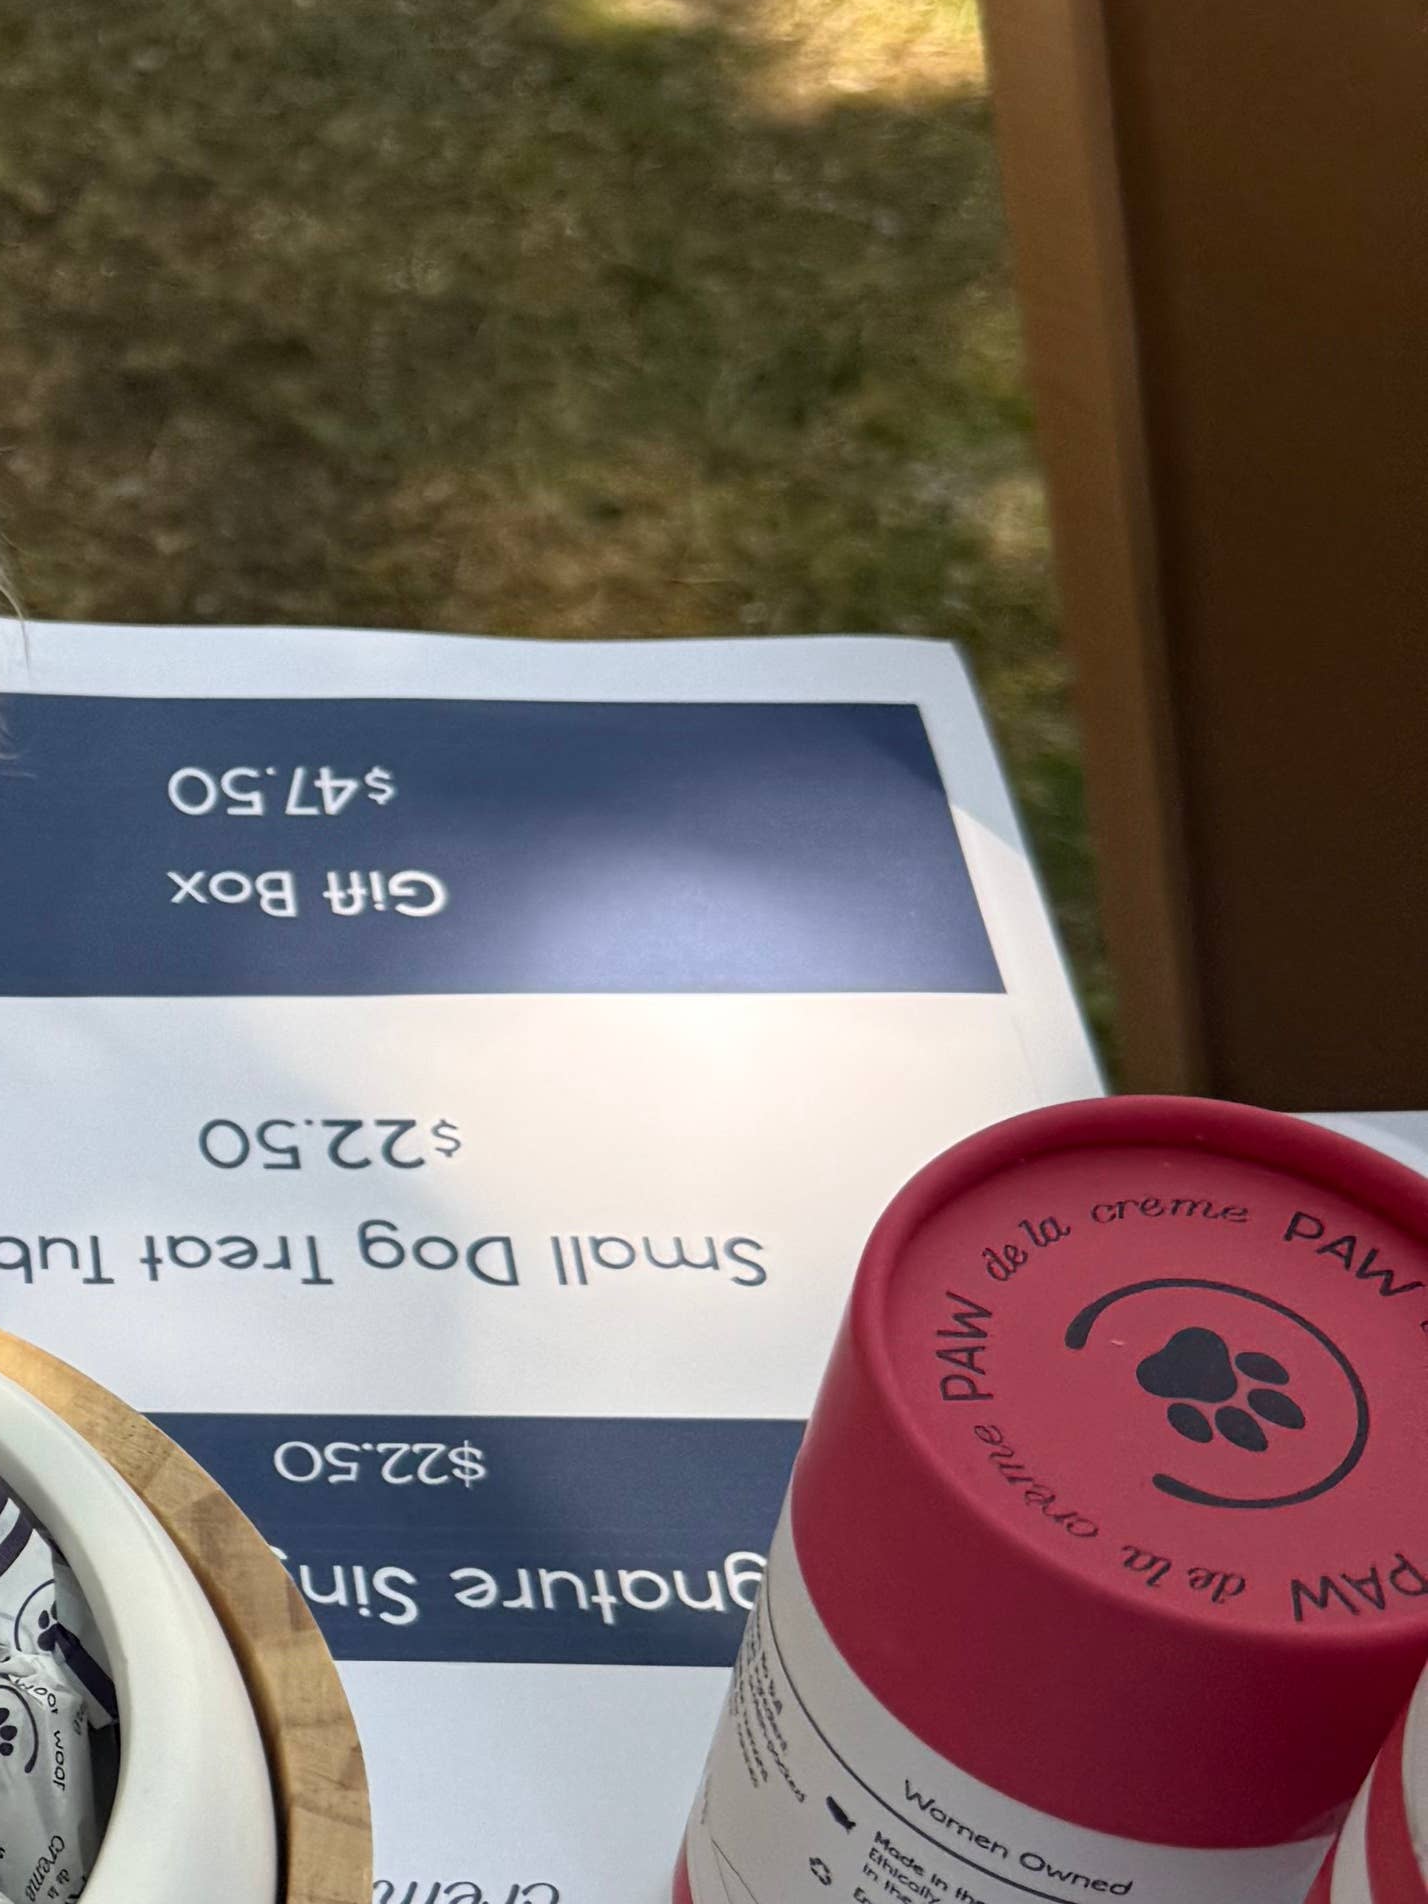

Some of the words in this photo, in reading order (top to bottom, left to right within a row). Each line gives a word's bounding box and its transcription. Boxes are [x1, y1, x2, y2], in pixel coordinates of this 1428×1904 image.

[167, 766, 397, 816] $47.50
[166, 869, 298, 918] Box
[323, 869, 449, 917] Gift
[197, 1117, 463, 1171] $22.50
[139, 1234, 334, 1286] Treat
[357, 1218, 520, 1287] Dog
[549, 1234, 768, 1287] Small
[936, 1291, 993, 1401] PAW
[982, 1244, 1029, 1282] de
[1018, 1217, 1071, 1248] la
[1283, 1211, 1425, 1297] PAW
[273, 1439, 488, 1487] $22.50
[276, 1551, 419, 1625] Sin
[449, 1552, 768, 1626] gnature
[1123, 1546, 1172, 1588] la
[1187, 1568, 1246, 1604] de
[1290, 1553, 1428, 1624] PAW
[874, 1830, 924, 1877] Made
[904, 1779, 1009, 1859] Women
[1019, 1851, 1134, 1896] Owned
